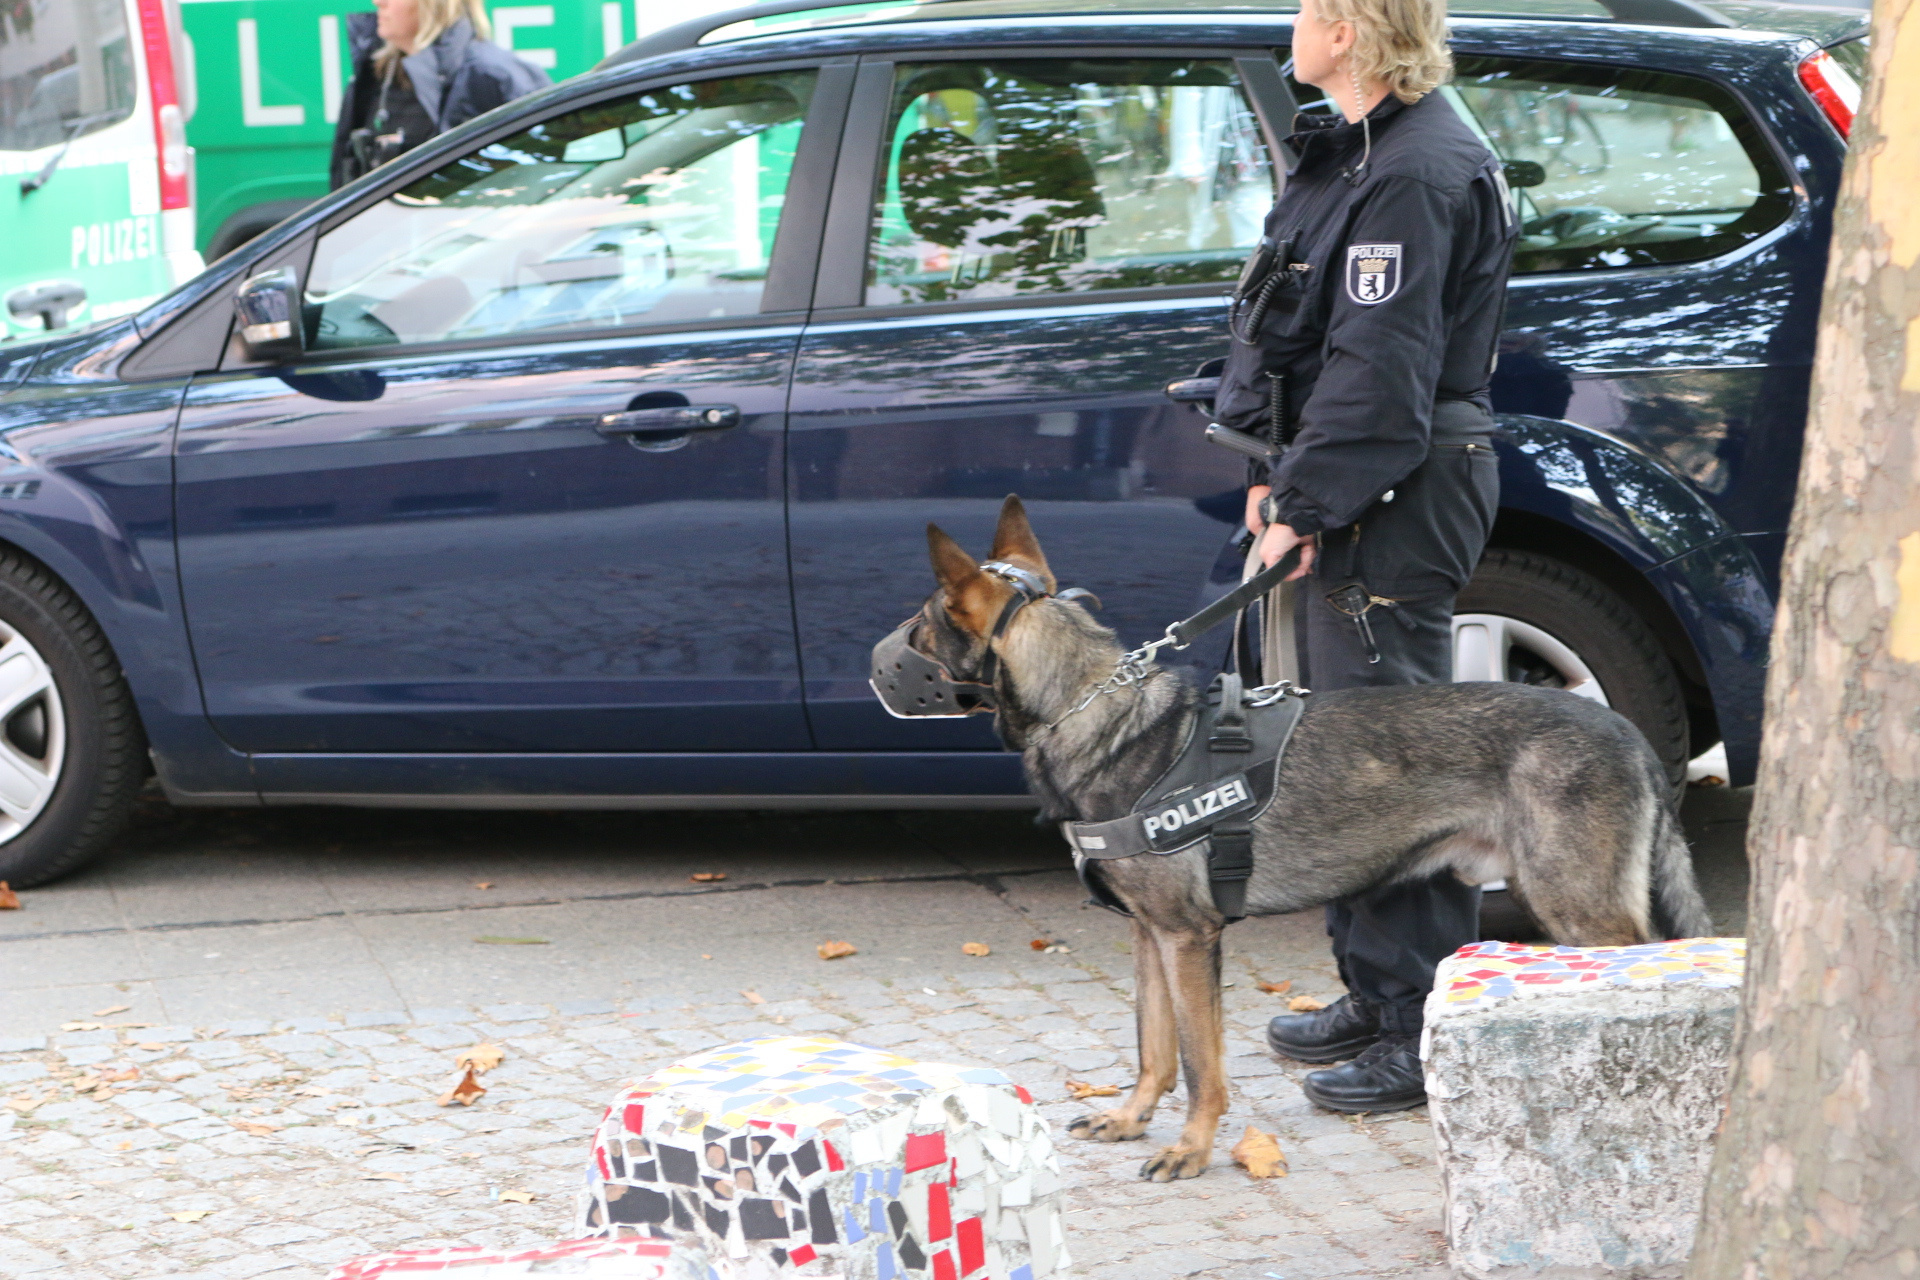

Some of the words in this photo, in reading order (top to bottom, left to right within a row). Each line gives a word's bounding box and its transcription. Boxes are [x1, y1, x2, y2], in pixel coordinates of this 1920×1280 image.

[71, 215, 157, 270] POLIZEI
[1350, 247, 1397, 260] POLIZEI
[1143, 779, 1248, 839] POLIZEI
